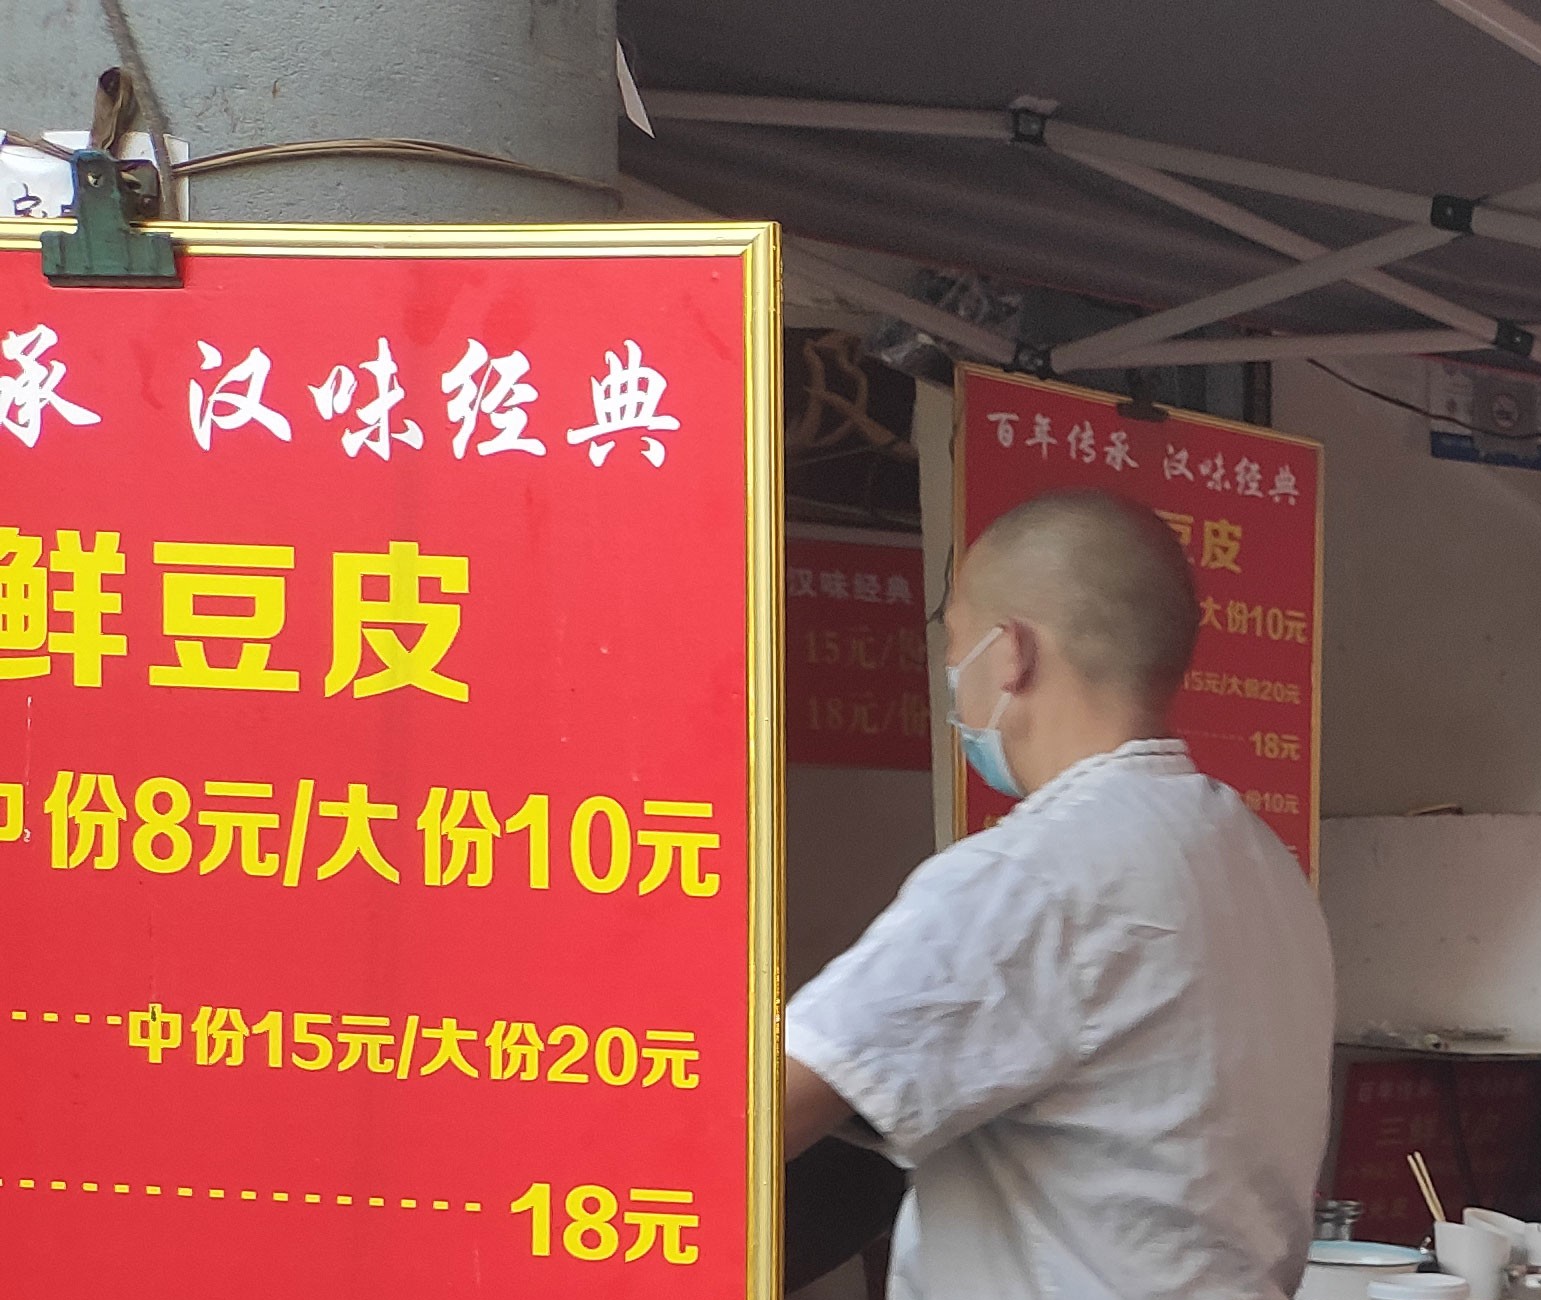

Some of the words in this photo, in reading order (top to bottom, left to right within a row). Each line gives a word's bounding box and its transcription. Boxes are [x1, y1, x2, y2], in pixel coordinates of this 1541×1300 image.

[0, 323, 101, 450] 承
[189, 337, 683, 469] 汉味经典
[987, 411, 1139, 472] 百年传承
[1163, 443, 1299, 506] 汉味经典
[0, 526, 471, 704] 鲜豆皮
[1200, 595, 1308, 644] 大份10元
[1253, 731, 1301, 760] 18元
[128, 1005, 701, 1091] 中份15元/大份20元
[510, 1182, 701, 1267] 18元
